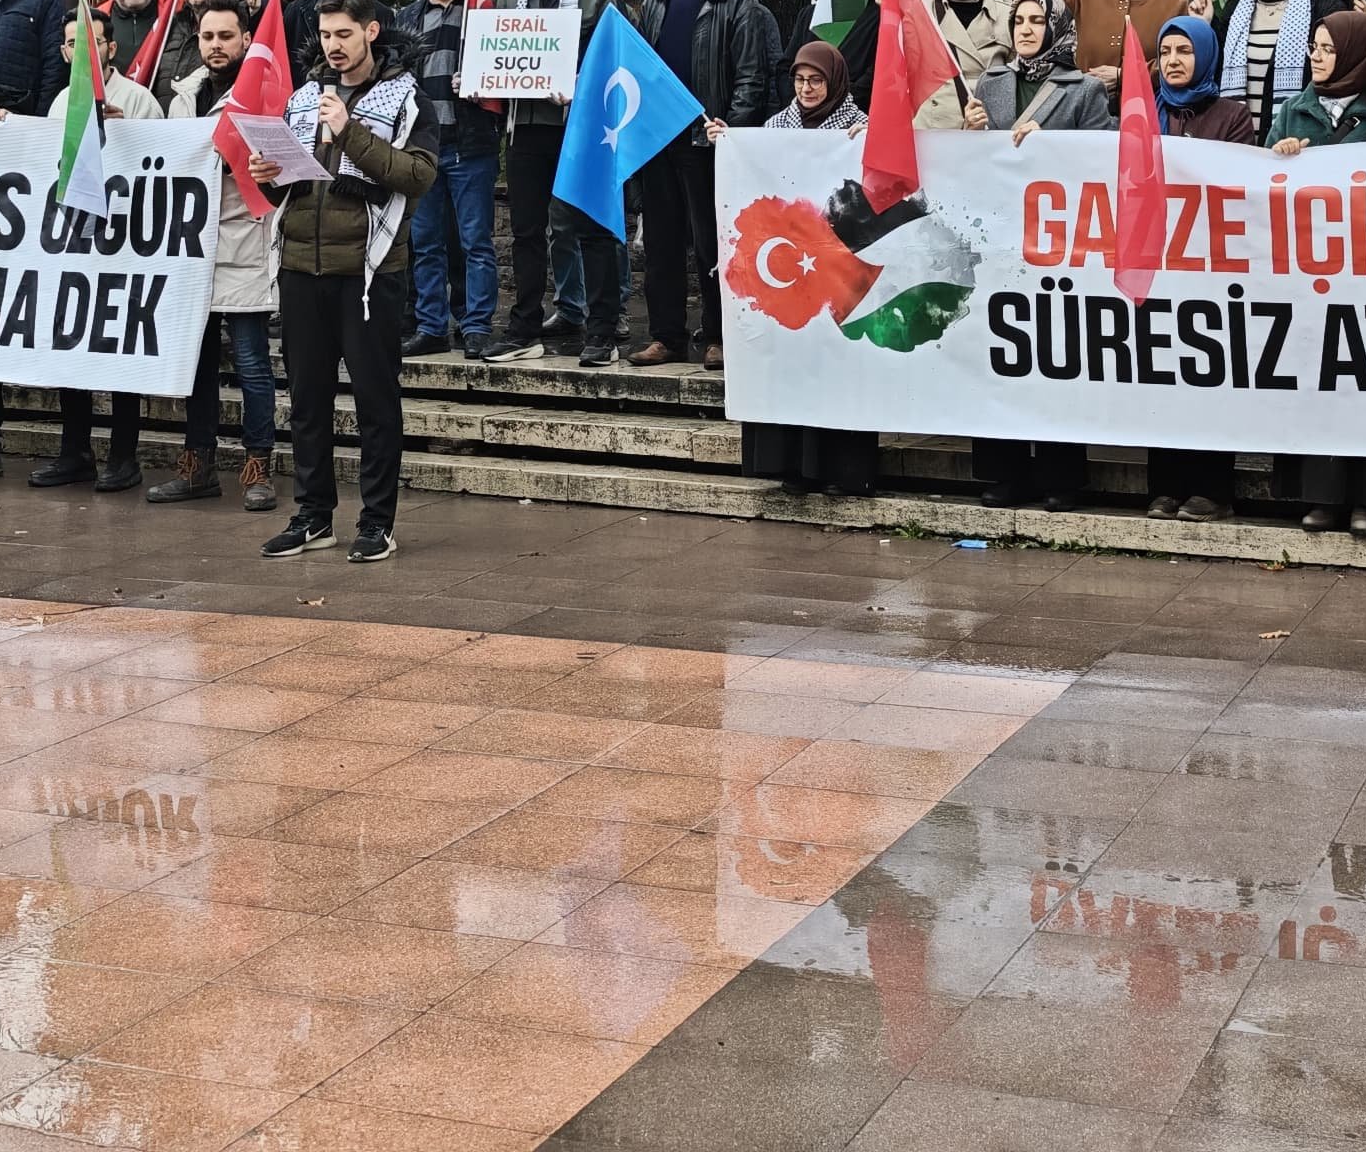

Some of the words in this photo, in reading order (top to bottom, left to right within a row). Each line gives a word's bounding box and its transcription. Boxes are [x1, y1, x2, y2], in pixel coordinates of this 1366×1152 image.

[495, 14, 548, 33] İSRAİL
[480, 34, 561, 52] İNSANLIK
[493, 56, 541, 73] SUÇU
[480, 72, 552, 91] İŞLİYOR!
[1022, 180, 1250, 274] GAZZE
[51, 271, 168, 358] DEK
[988, 275, 1299, 392] SÜRESİZ
